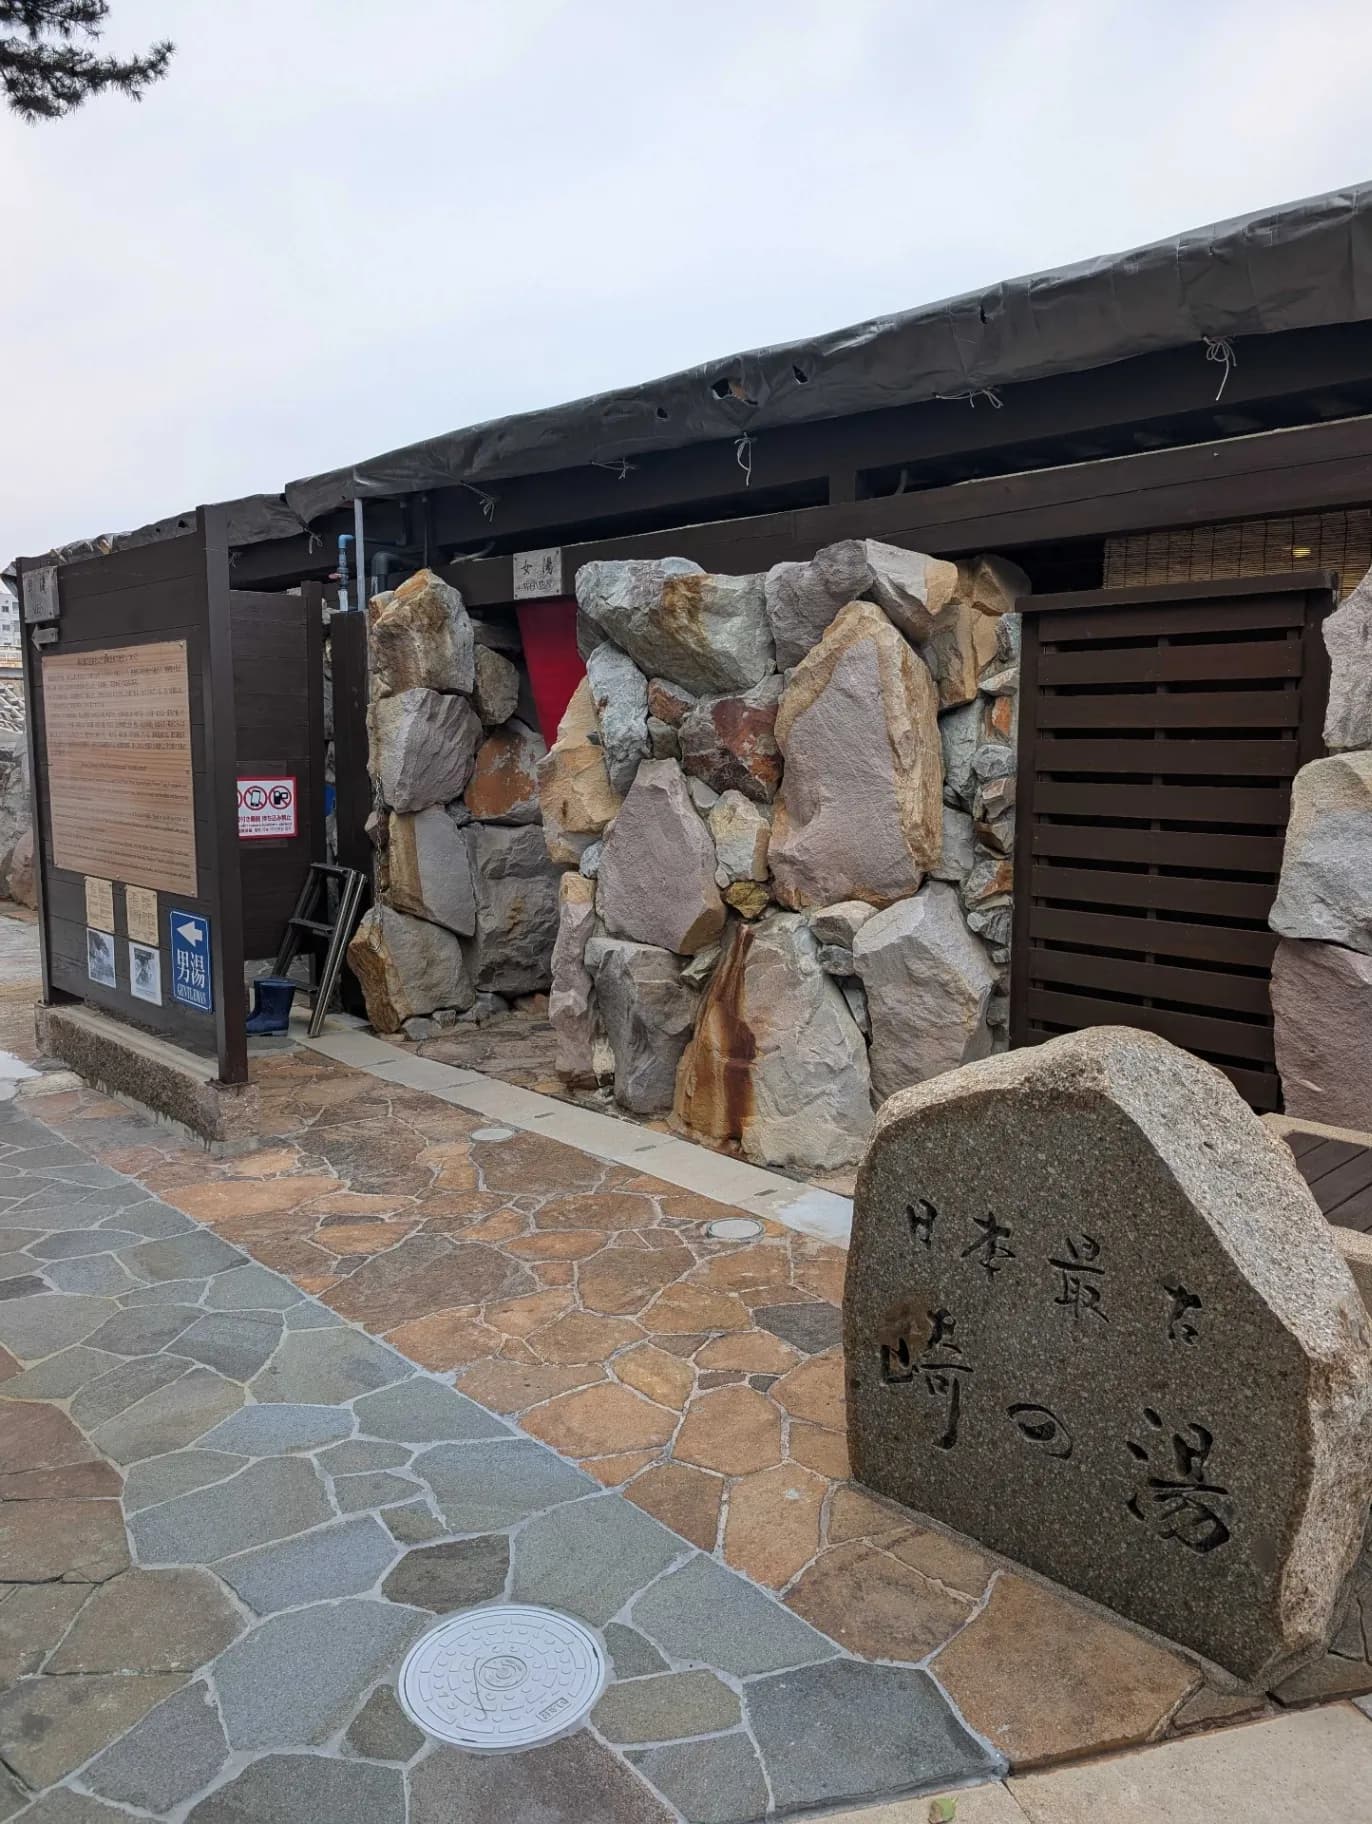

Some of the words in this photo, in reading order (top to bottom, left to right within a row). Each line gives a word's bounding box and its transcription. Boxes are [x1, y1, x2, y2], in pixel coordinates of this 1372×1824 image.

[176, 948, 205, 989] 男湯
[906, 1199, 1202, 1345] 日本最古
[881, 1308, 1231, 1554] 崎の湯
